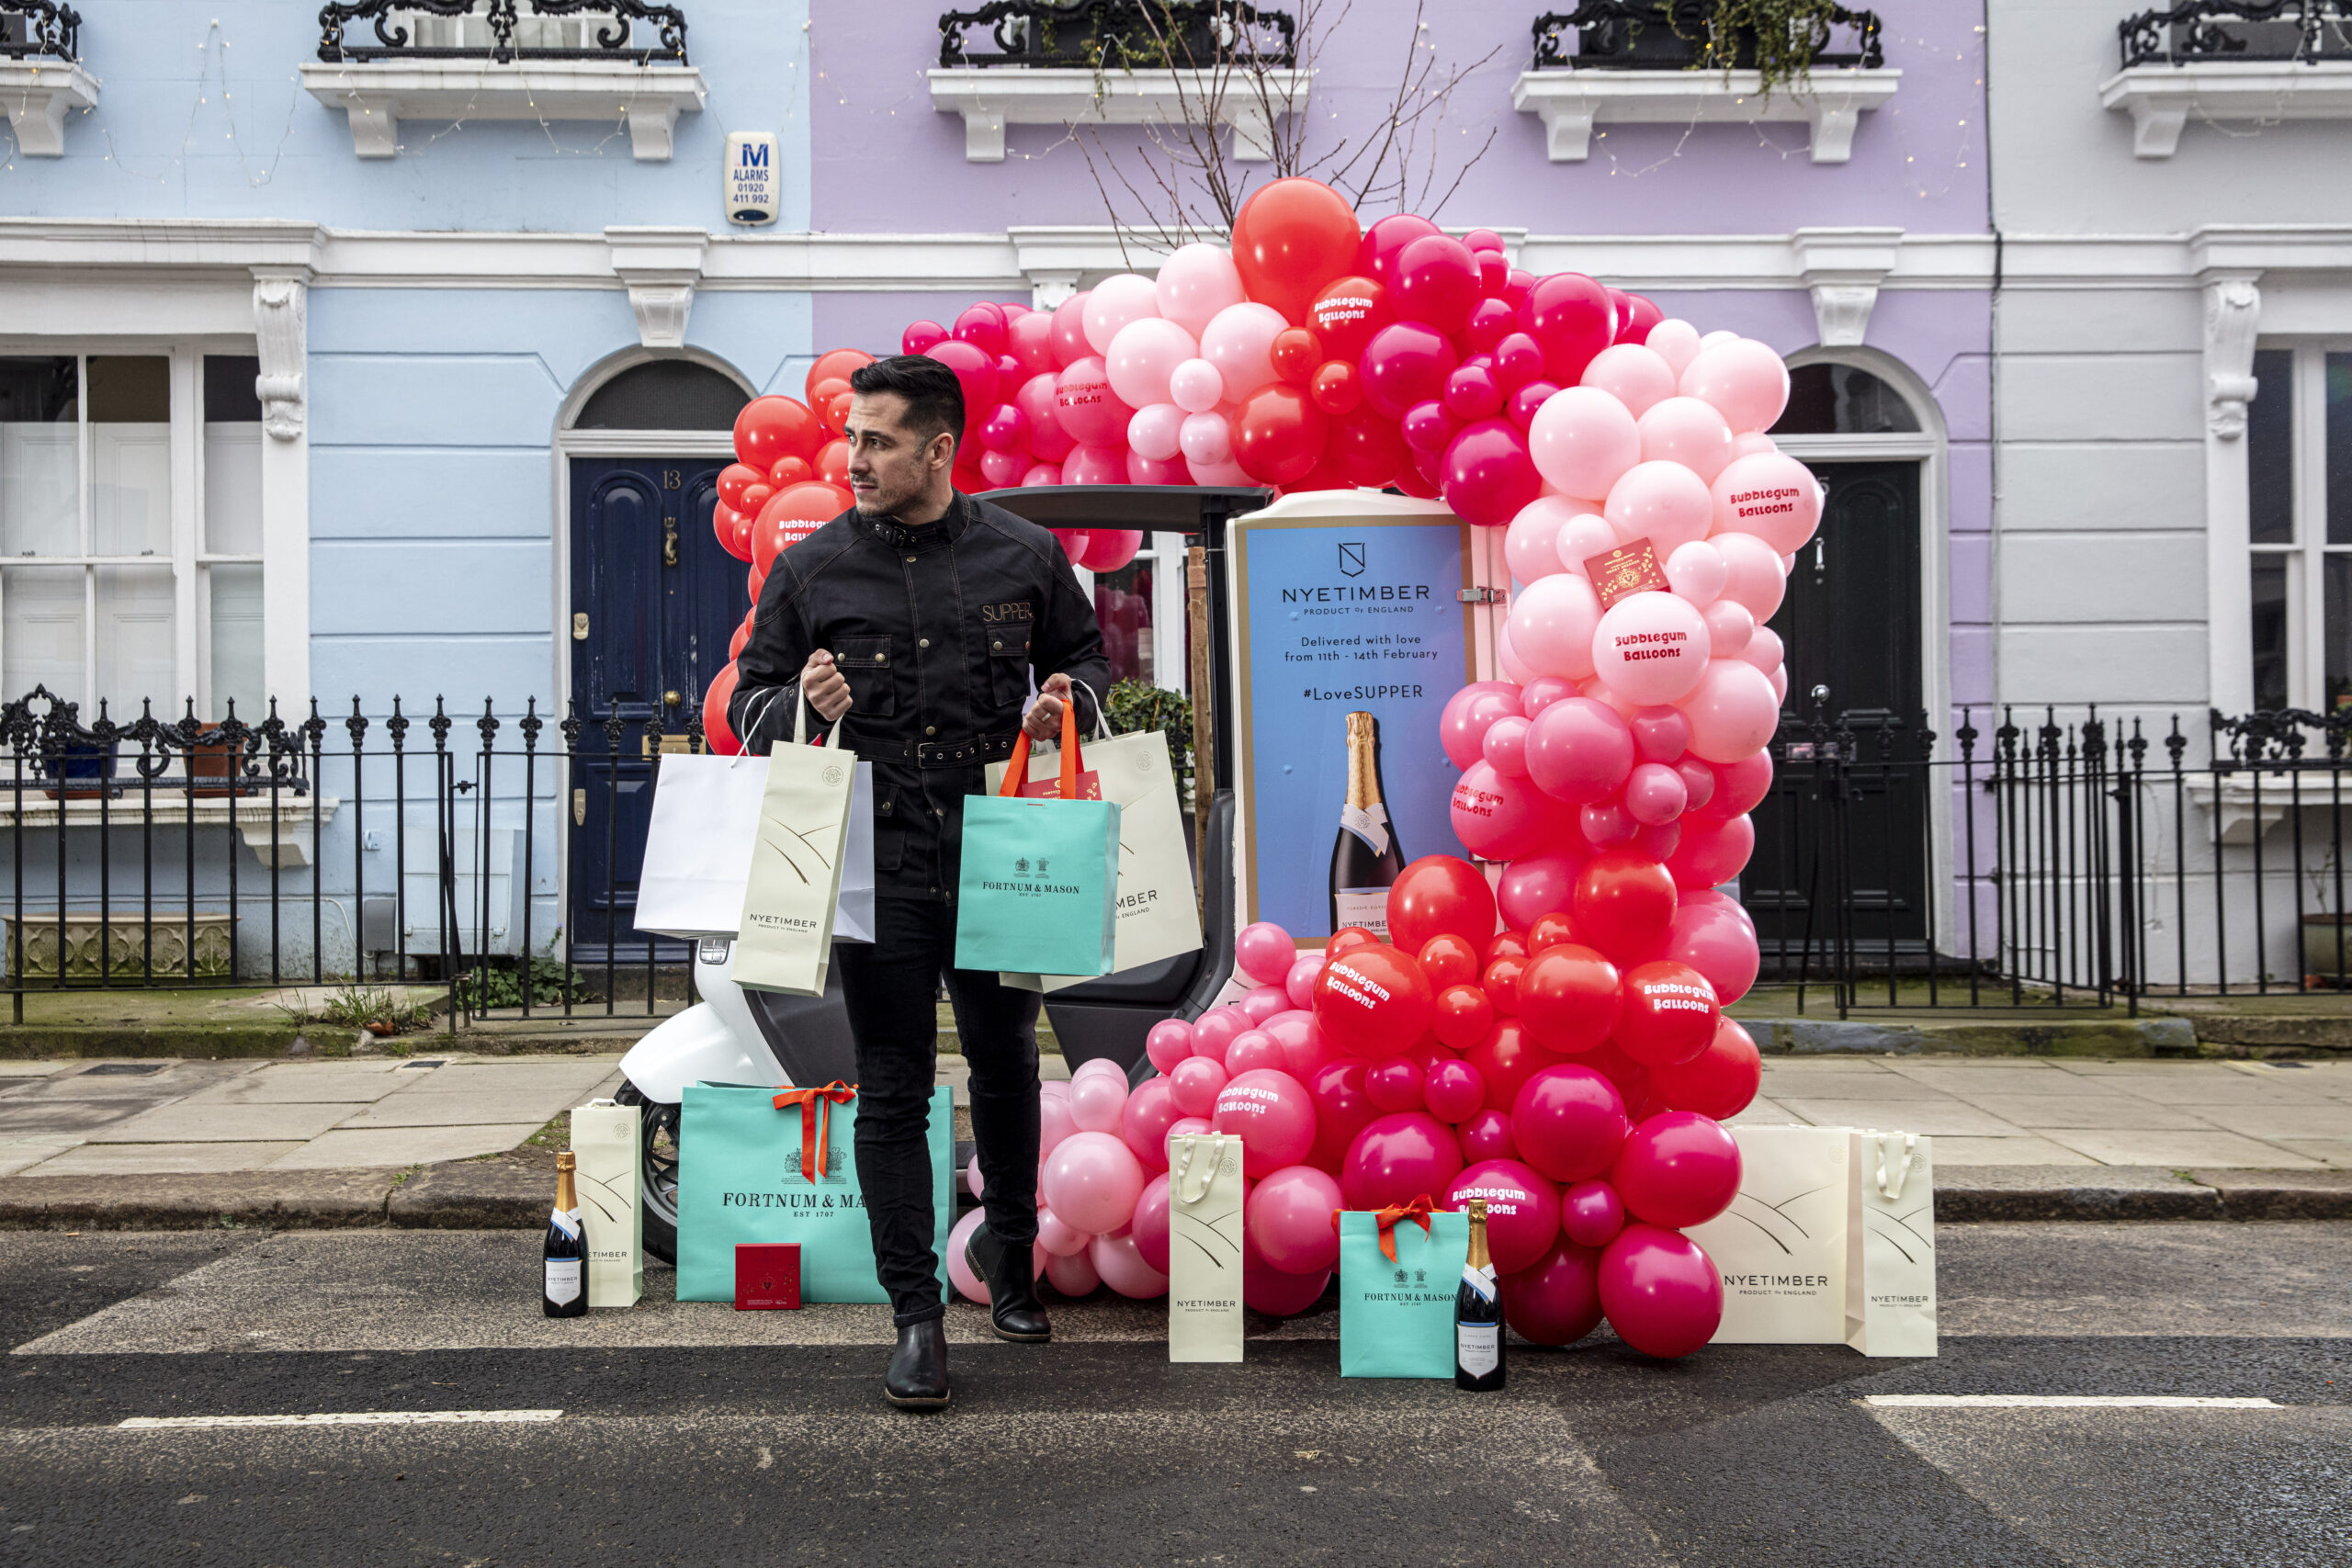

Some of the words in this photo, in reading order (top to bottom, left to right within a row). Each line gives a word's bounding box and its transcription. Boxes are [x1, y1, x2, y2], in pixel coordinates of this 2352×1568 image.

[742, 143, 769, 167] M
[733, 169, 770, 182] ALARMS
[738, 184, 764, 193] 01920
[733, 194, 750, 203] 411
[752, 194, 769, 204] 992
[1314, 297, 1374, 313] Bubblegum
[1318, 310, 1365, 323] Balloons
[1059, 395, 1102, 407] Baloons
[663, 470, 682, 490] 13
[1730, 488, 1800, 504] Bubblegum
[1738, 503, 1793, 517] Balloons
[779, 519, 829, 531] Bubbleg
[785, 532, 811, 542] Ball
[1283, 585, 1430, 604] NYETIMBER
[982, 602, 1032, 622] SUPPER
[1304, 607, 1351, 615] PRODUCT
[1367, 605, 1414, 614] ENGLAND
[1301, 635, 1361, 647] Delivered
[1365, 634, 1391, 645] with
[1396, 634, 1421, 644] love
[1615, 631, 1687, 647] Bubblegum
[1284, 651, 1313, 662] from
[1317, 650, 1340, 661] 11th
[1353, 649, 1378, 660] 14th
[1384, 649, 1438, 660] February
[1623, 648, 1680, 661] Balloons
[1303, 684, 1424, 701] #LoveSUPPER
[1455, 784, 1504, 806] ubblegum
[982, 881, 1032, 893] FORTNUM
[1035, 883, 1042, 893] &
[1045, 884, 1080, 895] MASON
[1121, 907, 1150, 919] ENGLAND
[750, 913, 817, 929] NYETIMBER
[1342, 919, 1387, 929] NYETIMBE
[1329, 961, 1390, 1002] Bubblegum
[1326, 976, 1376, 1010] Balloons
[1644, 983, 1714, 1002] Bubblegum
[1653, 998, 1709, 1014] Balloons
[1218, 1101, 1266, 1114] Balloons
[722, 1192, 817, 1208] FORTNUM
[821, 1194, 834, 1208] &
[1453, 1187, 1526, 1201] Bubblegum
[1459, 1203, 1517, 1215] Boons
[1724, 1275, 1828, 1287] NYETIMBER
[1364, 1292, 1412, 1303] FORTNUM
[1414, 1293, 1421, 1302] &
[1423, 1293, 1457, 1303] MASON
[1871, 1295, 1928, 1303] NYETIMBER
